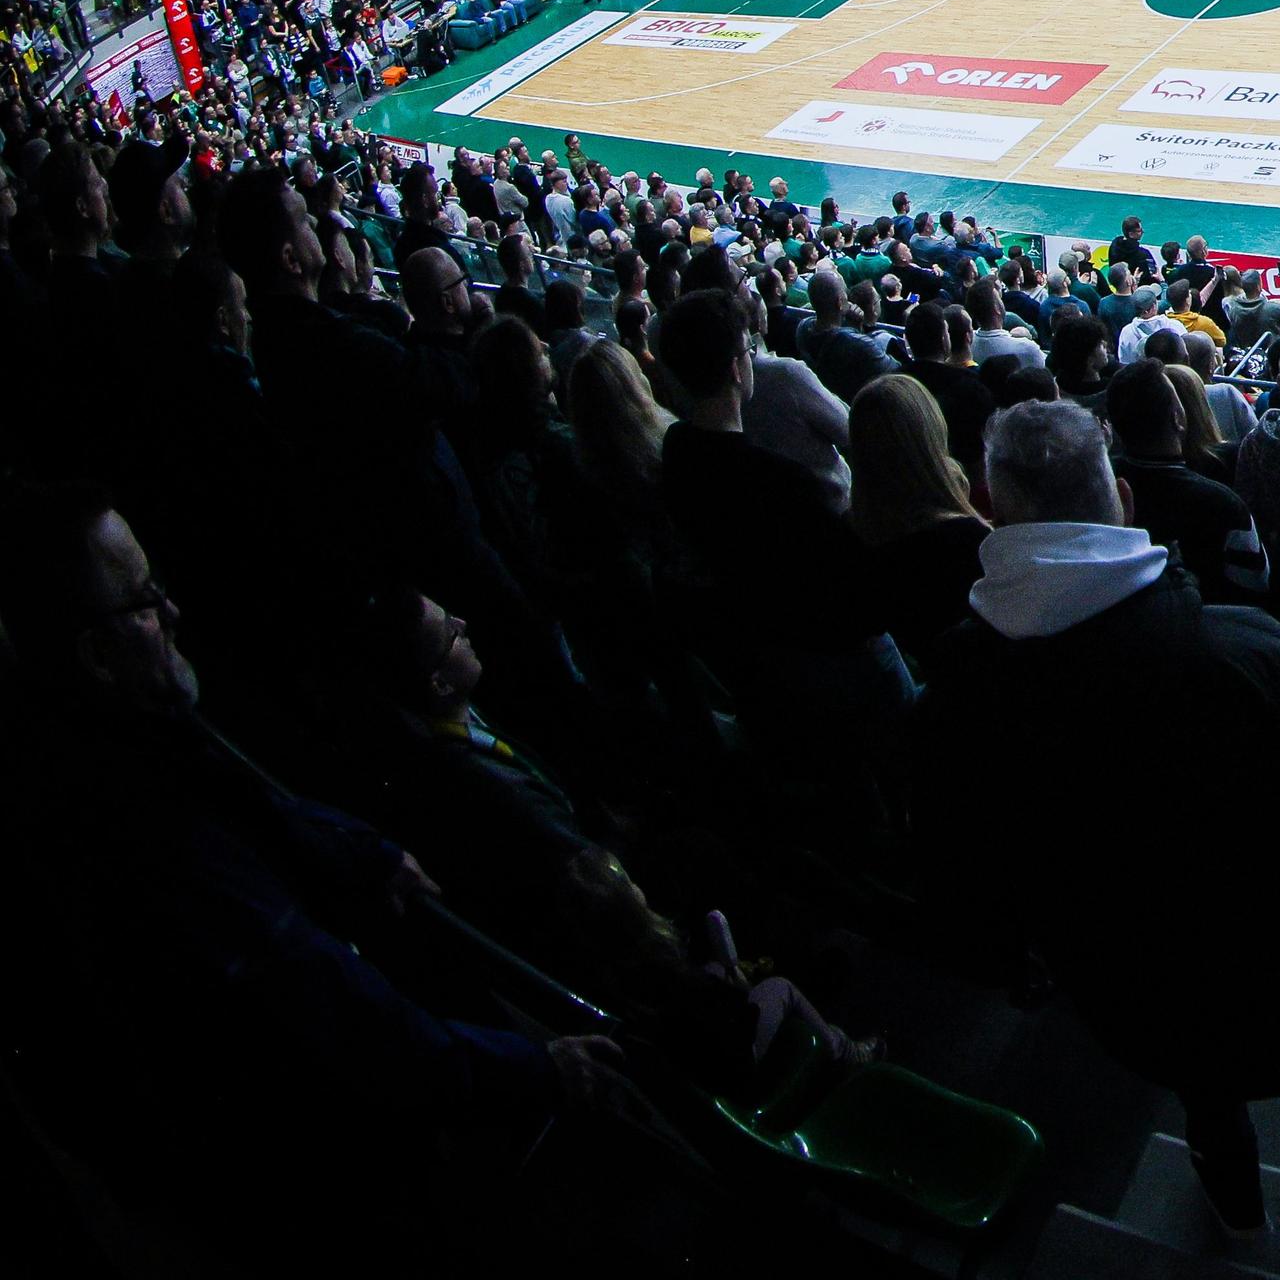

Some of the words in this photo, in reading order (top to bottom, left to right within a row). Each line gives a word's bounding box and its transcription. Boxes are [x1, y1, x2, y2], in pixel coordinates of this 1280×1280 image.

[642, 20, 726, 34] BRICO
[500, 19, 594, 76] perceptus
[937, 69, 1062, 91] ORLEN
